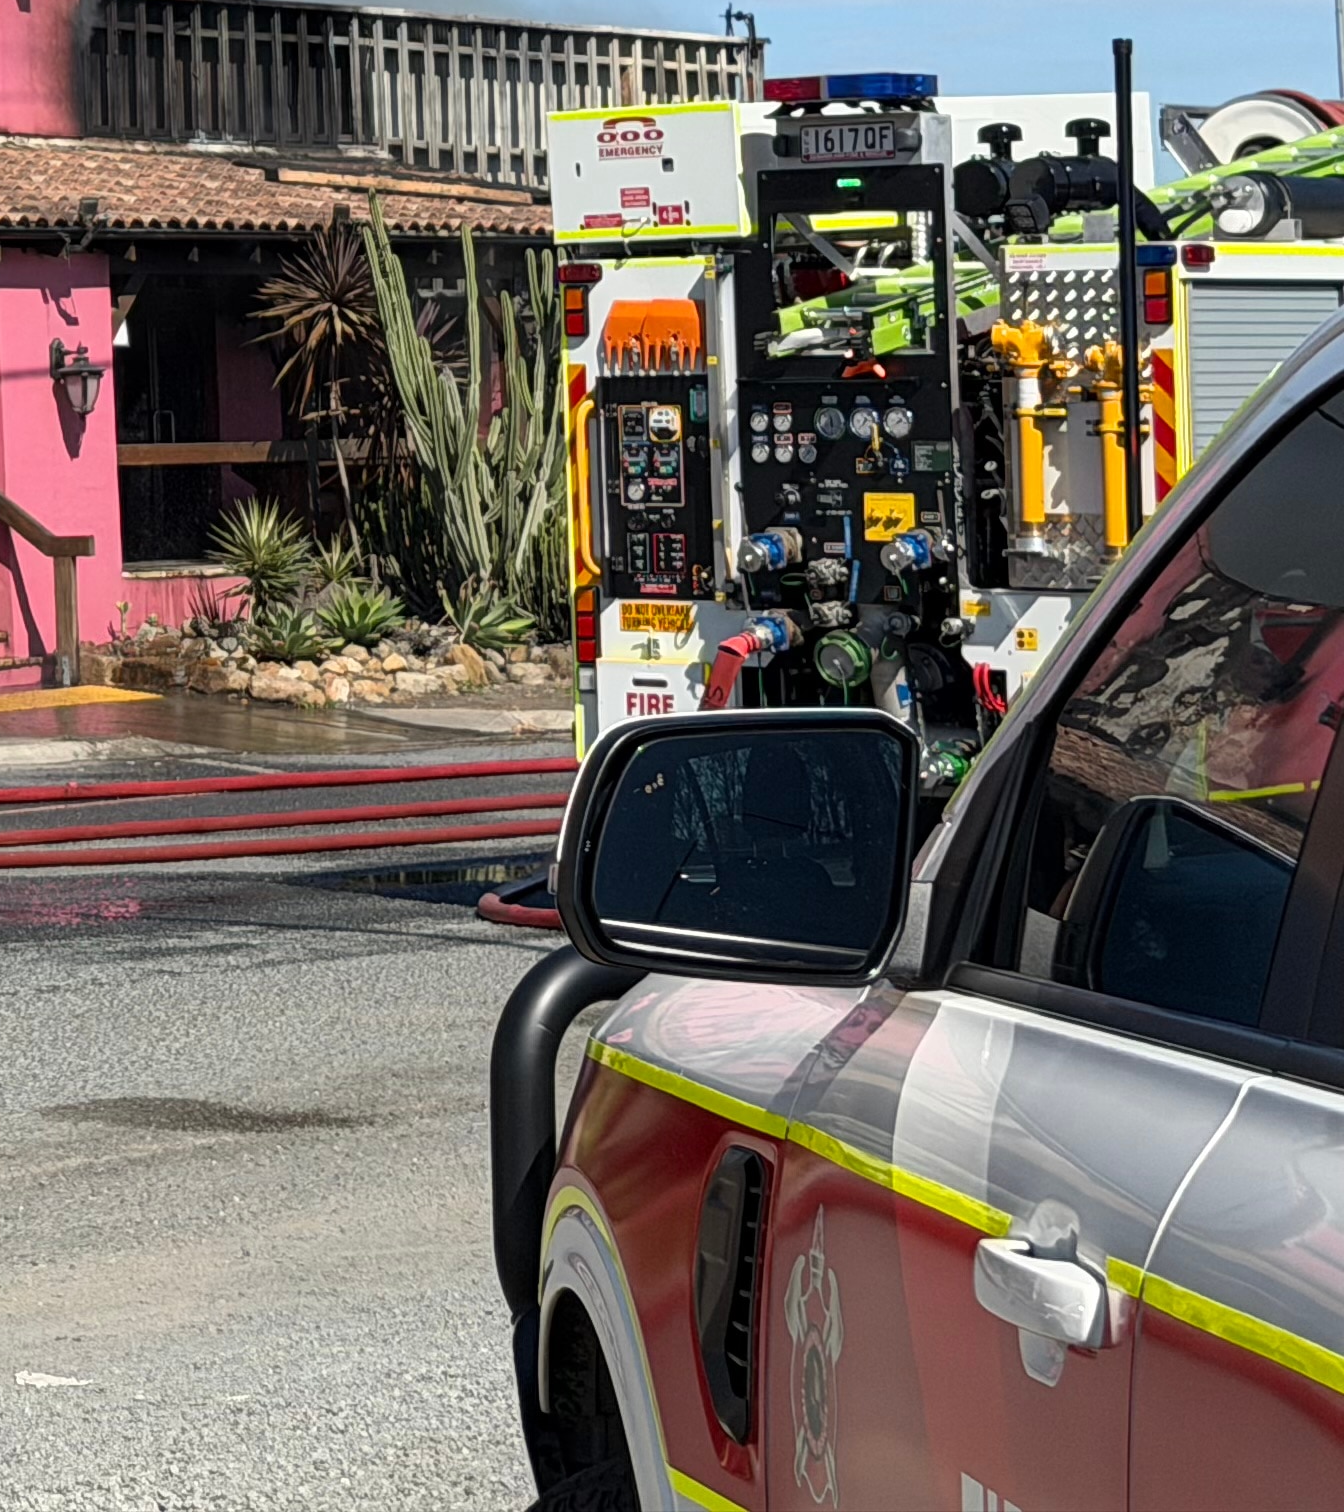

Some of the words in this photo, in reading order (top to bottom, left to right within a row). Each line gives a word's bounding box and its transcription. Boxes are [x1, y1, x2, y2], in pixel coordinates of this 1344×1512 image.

[598, 144, 664, 158] EMERGENCY
[621, 603, 633, 617] DO
[634, 603, 650, 617] NOT
[625, 692, 675, 717] FIRE
